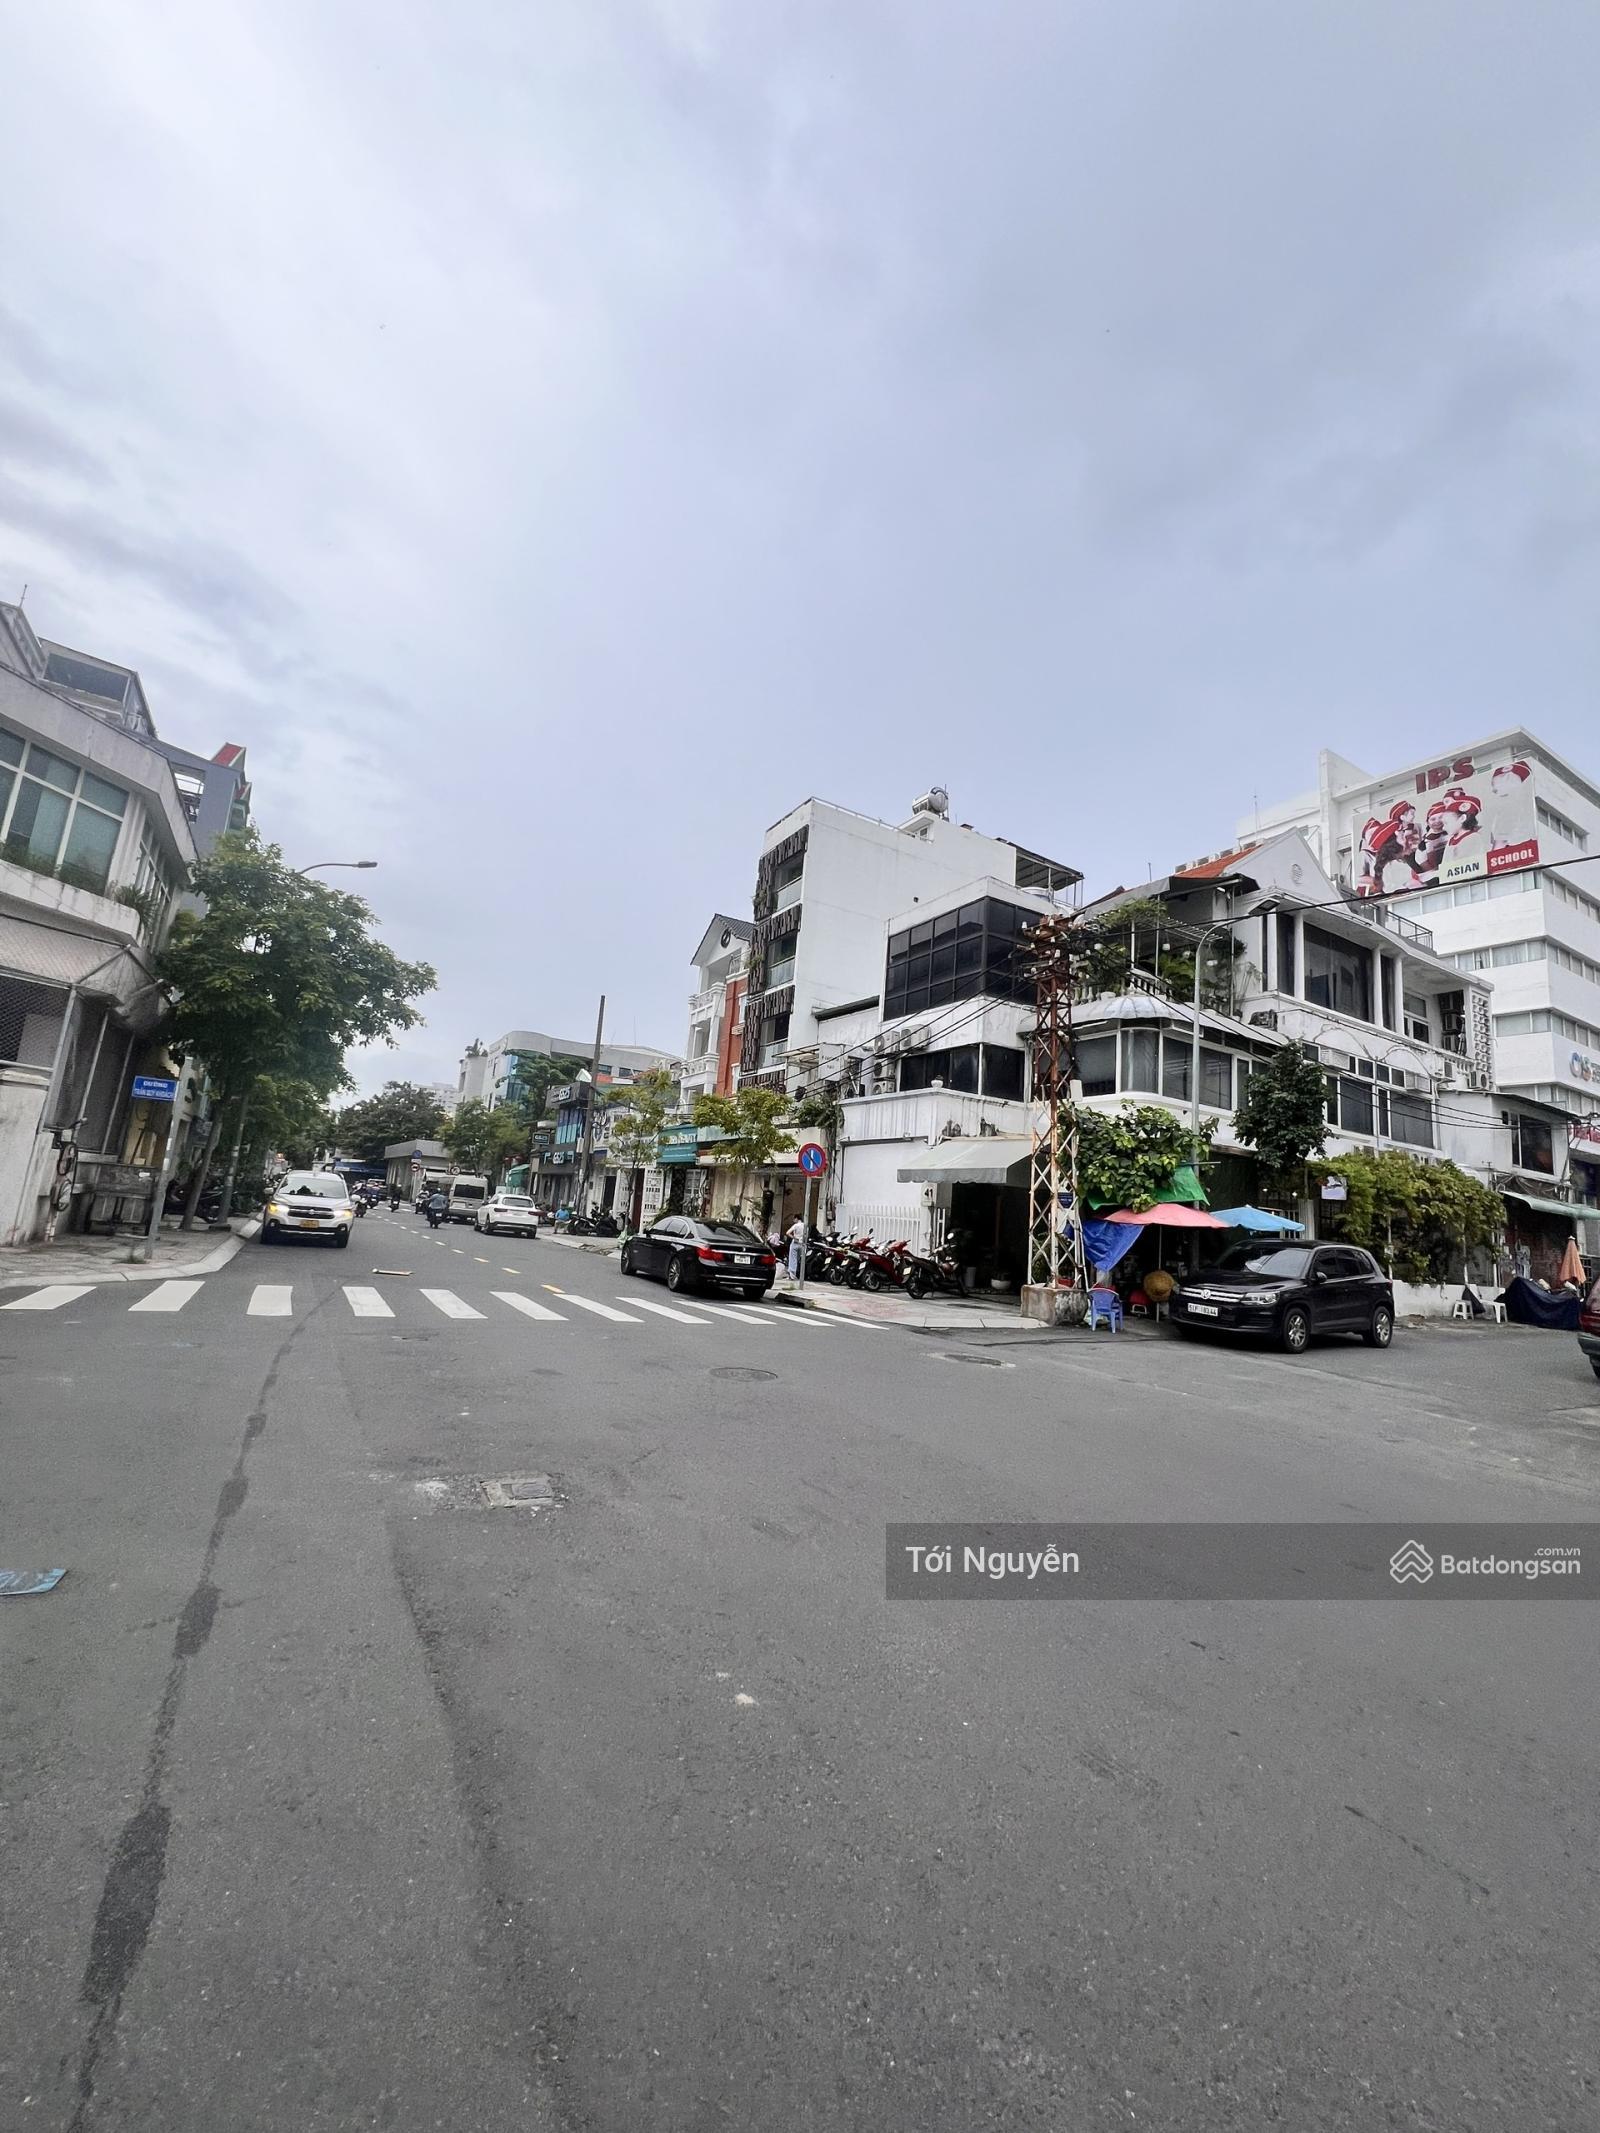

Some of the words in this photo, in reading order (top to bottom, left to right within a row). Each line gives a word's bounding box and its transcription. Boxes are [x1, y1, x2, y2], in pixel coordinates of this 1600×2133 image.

[1416, 756, 1475, 794] IPS
[1447, 862, 1480, 878] ASIAN
[1490, 848, 1534, 867] SCHOOL
[924, 1188, 933, 1198] 41
